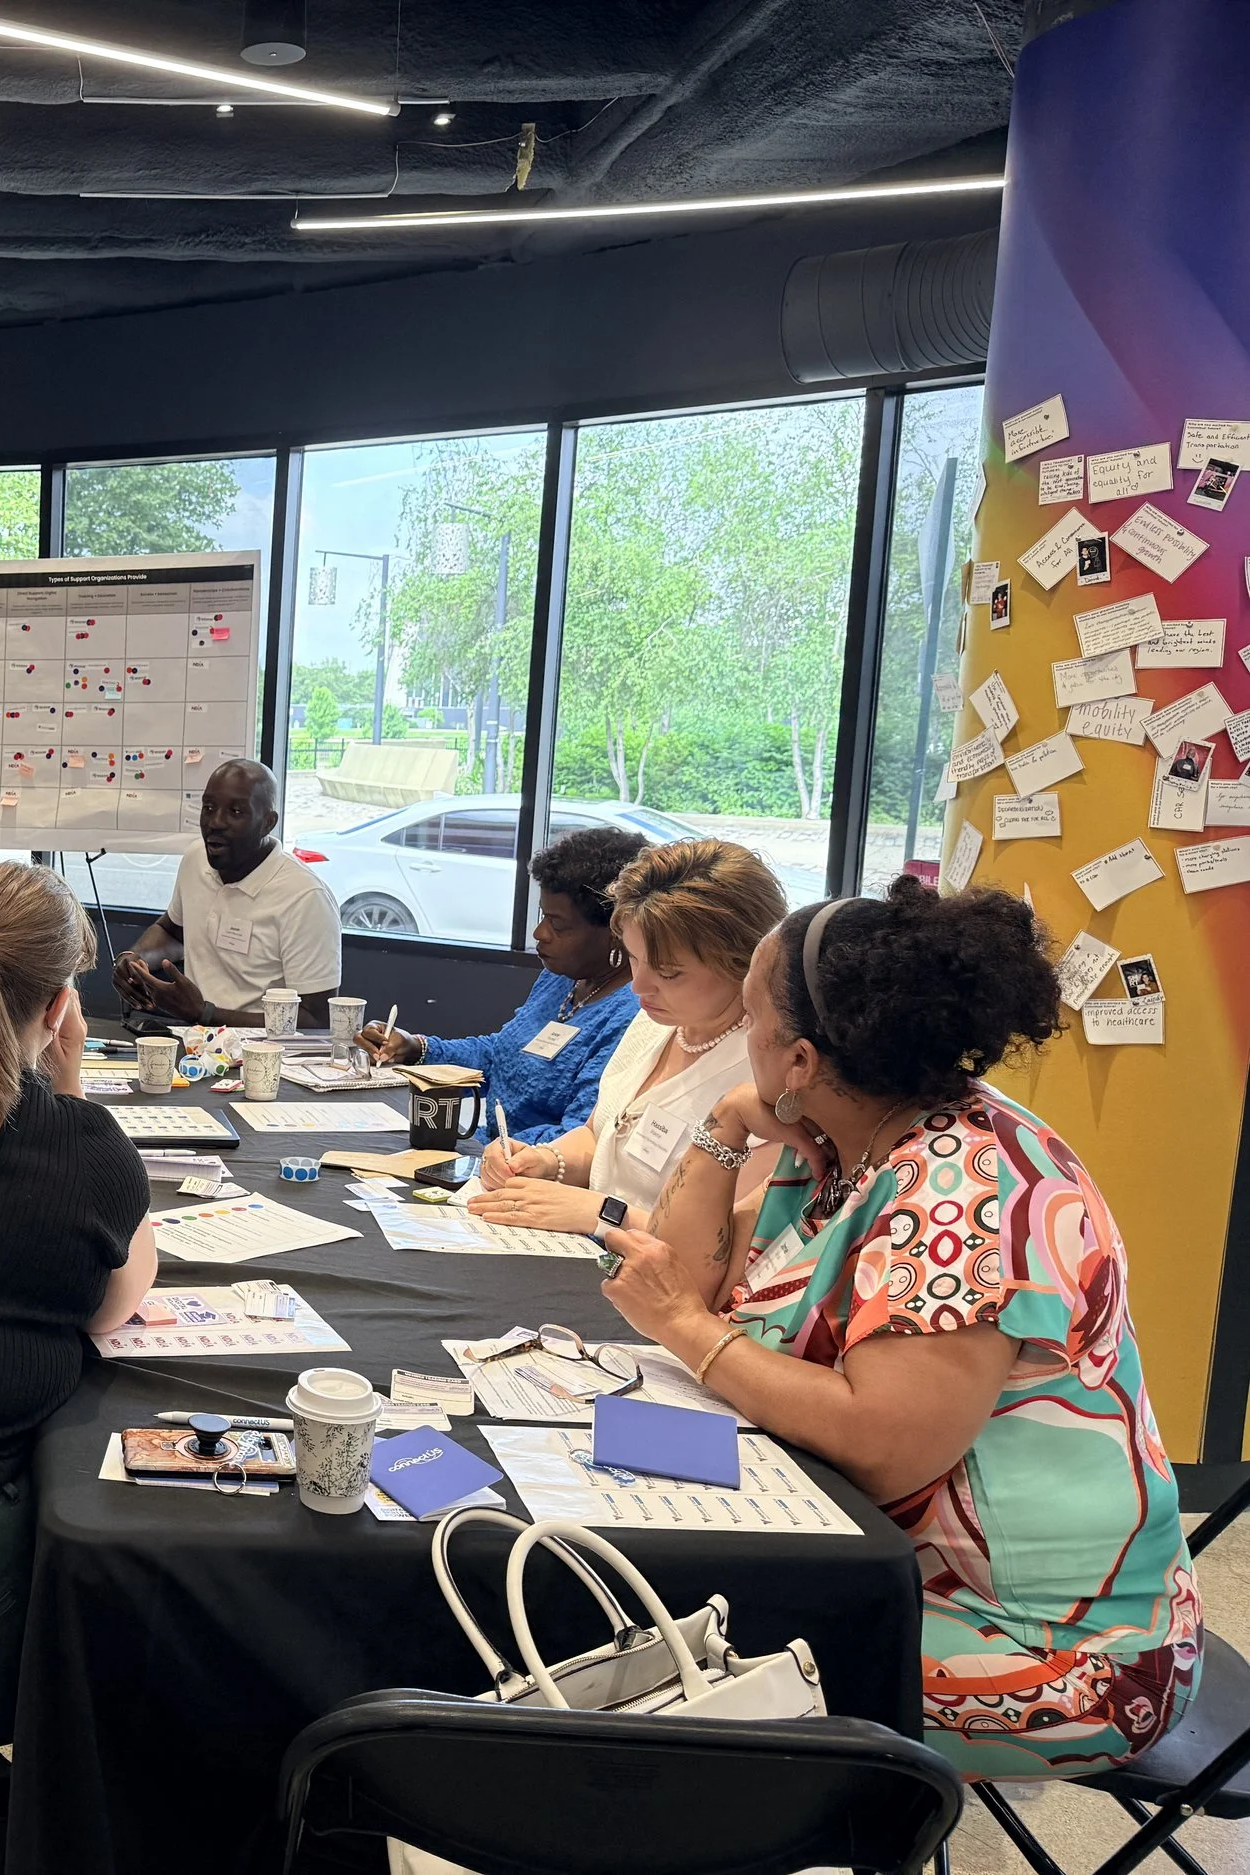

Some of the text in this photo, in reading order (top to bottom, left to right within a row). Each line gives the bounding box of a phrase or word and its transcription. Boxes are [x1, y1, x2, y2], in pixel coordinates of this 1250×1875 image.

[1092, 456, 1157, 475] Equity and
[1093, 476, 1131, 488] equality
[1116, 487, 1129, 496] all
[1134, 515, 1164, 536] Endless
[1036, 549, 1056, 569] Access
[1136, 546, 1162, 564] growth
[48, 576, 63, 584] Types
[70, 575, 91, 583] Support
[91, 574, 126, 583] Organizations
[1147, 646, 1172, 655] leading
[1074, 701, 1136, 724] mobility
[1082, 721, 1132, 739] equity
[1173, 801, 1184, 819] CAR
[1085, 1006, 1158, 1018] improved access
[1092, 1017, 1156, 1026] to healthcare
[409, 1092, 460, 1130] RT
[232, 1417, 270, 1427] connectUS
